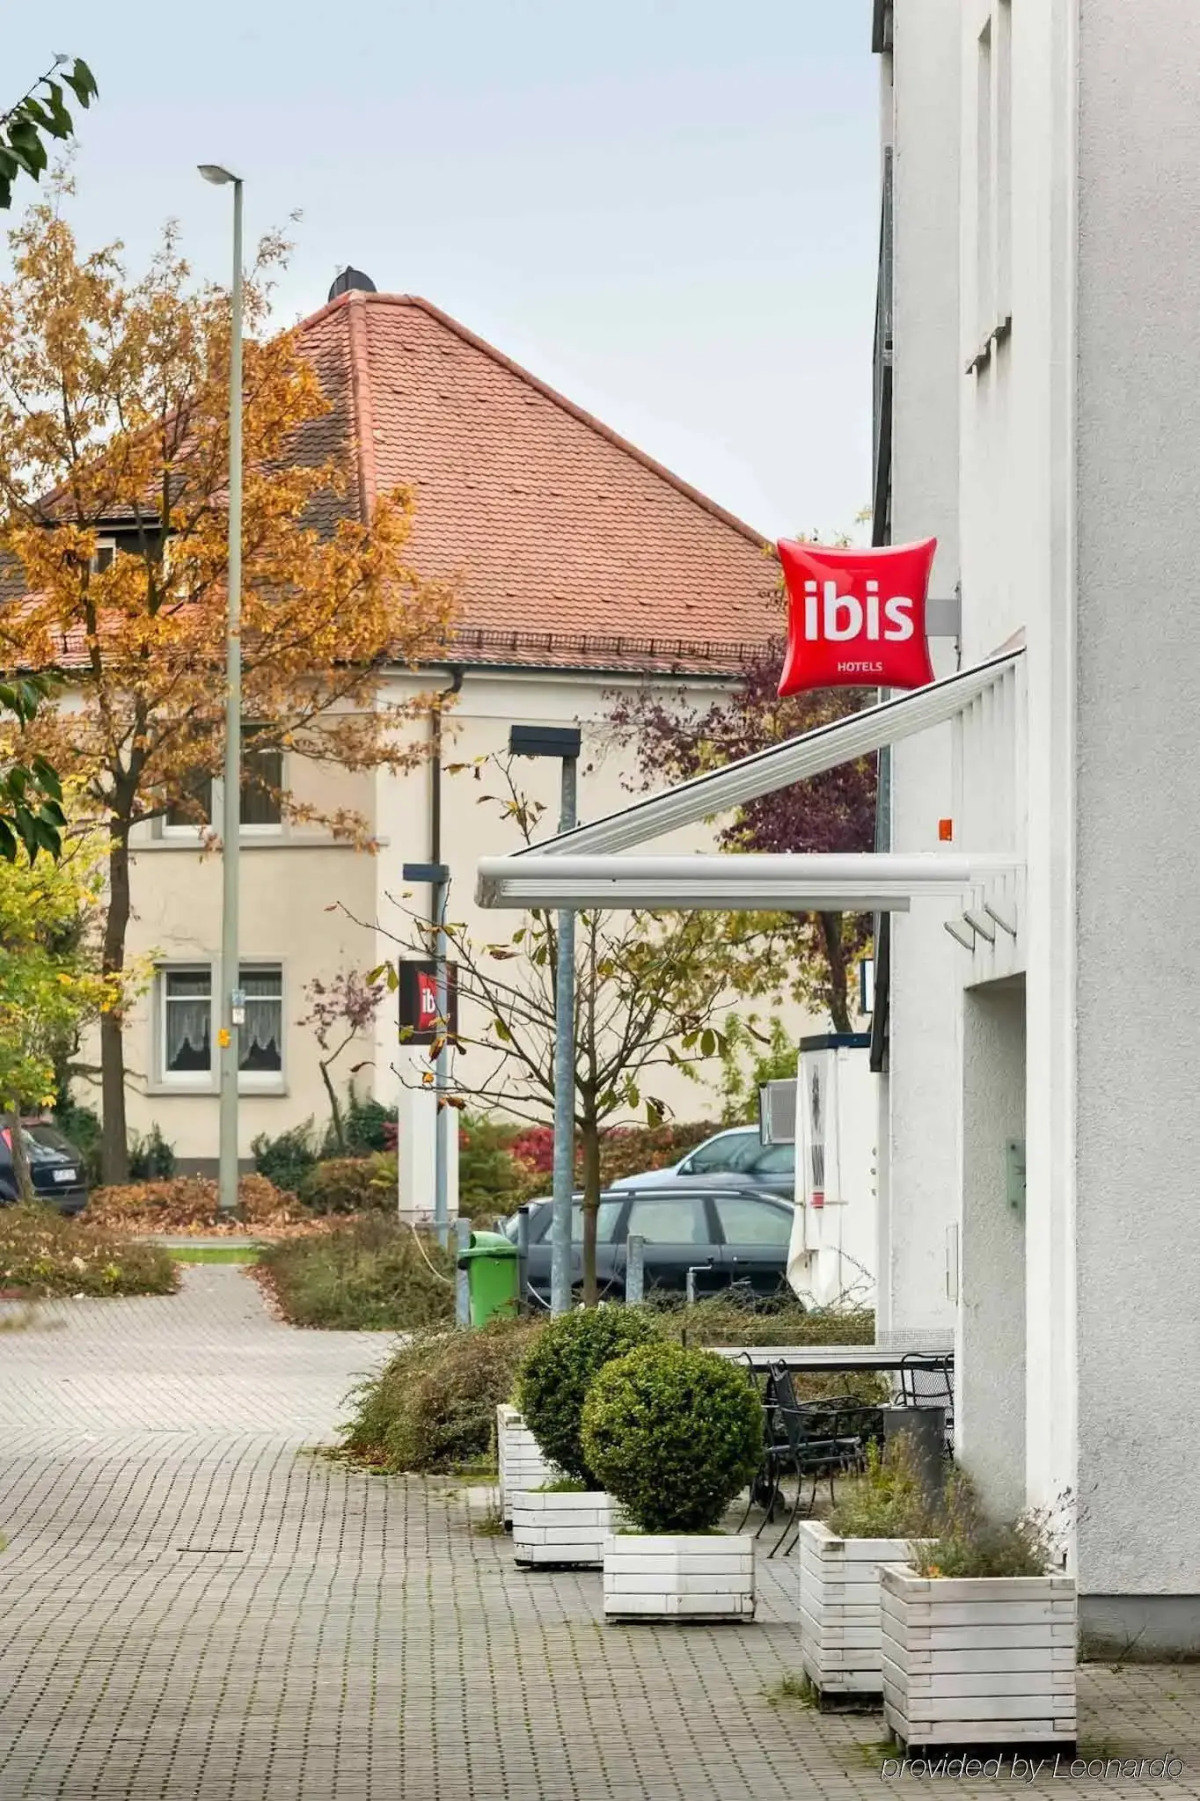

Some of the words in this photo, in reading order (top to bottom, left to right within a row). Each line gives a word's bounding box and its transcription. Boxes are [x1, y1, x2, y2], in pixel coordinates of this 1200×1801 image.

[804, 580, 914, 641] ibis
[837, 661, 883, 672] HOTELS
[422, 988, 436, 1013] ib
